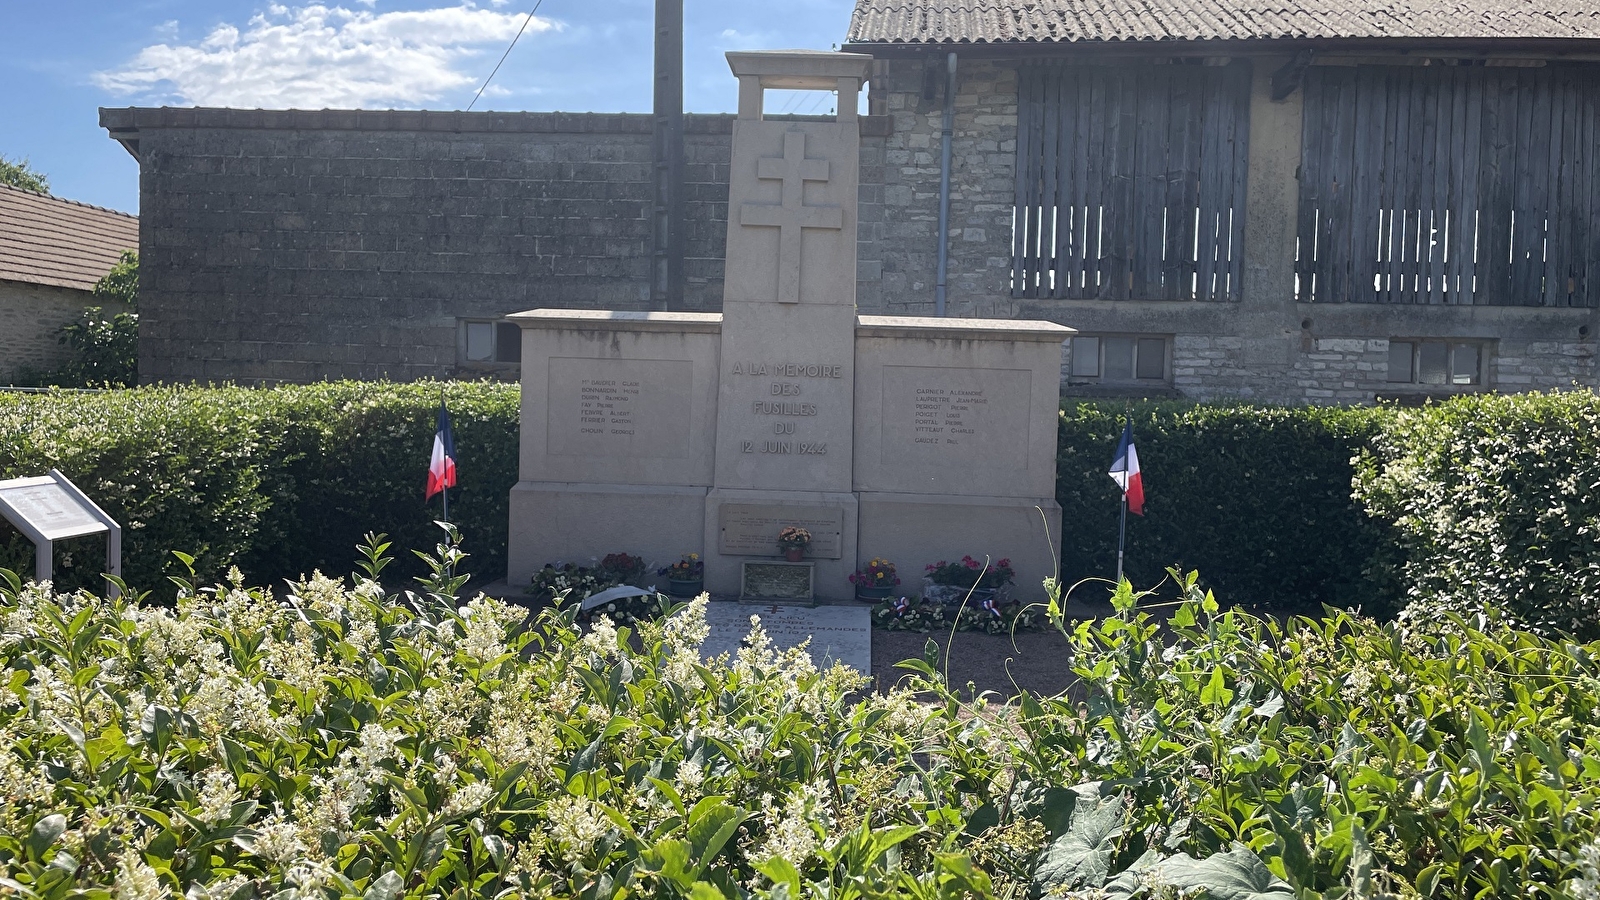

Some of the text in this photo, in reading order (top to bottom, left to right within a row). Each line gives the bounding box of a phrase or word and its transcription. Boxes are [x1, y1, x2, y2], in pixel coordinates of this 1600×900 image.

[731, 362, 842, 378] A LA MEMOIRE
[771, 382, 800, 396] DES
[752, 401, 818, 417] FUSILLES
[773, 421, 796, 435] DU
[740, 441, 828, 456] 12 JUIN 1944
